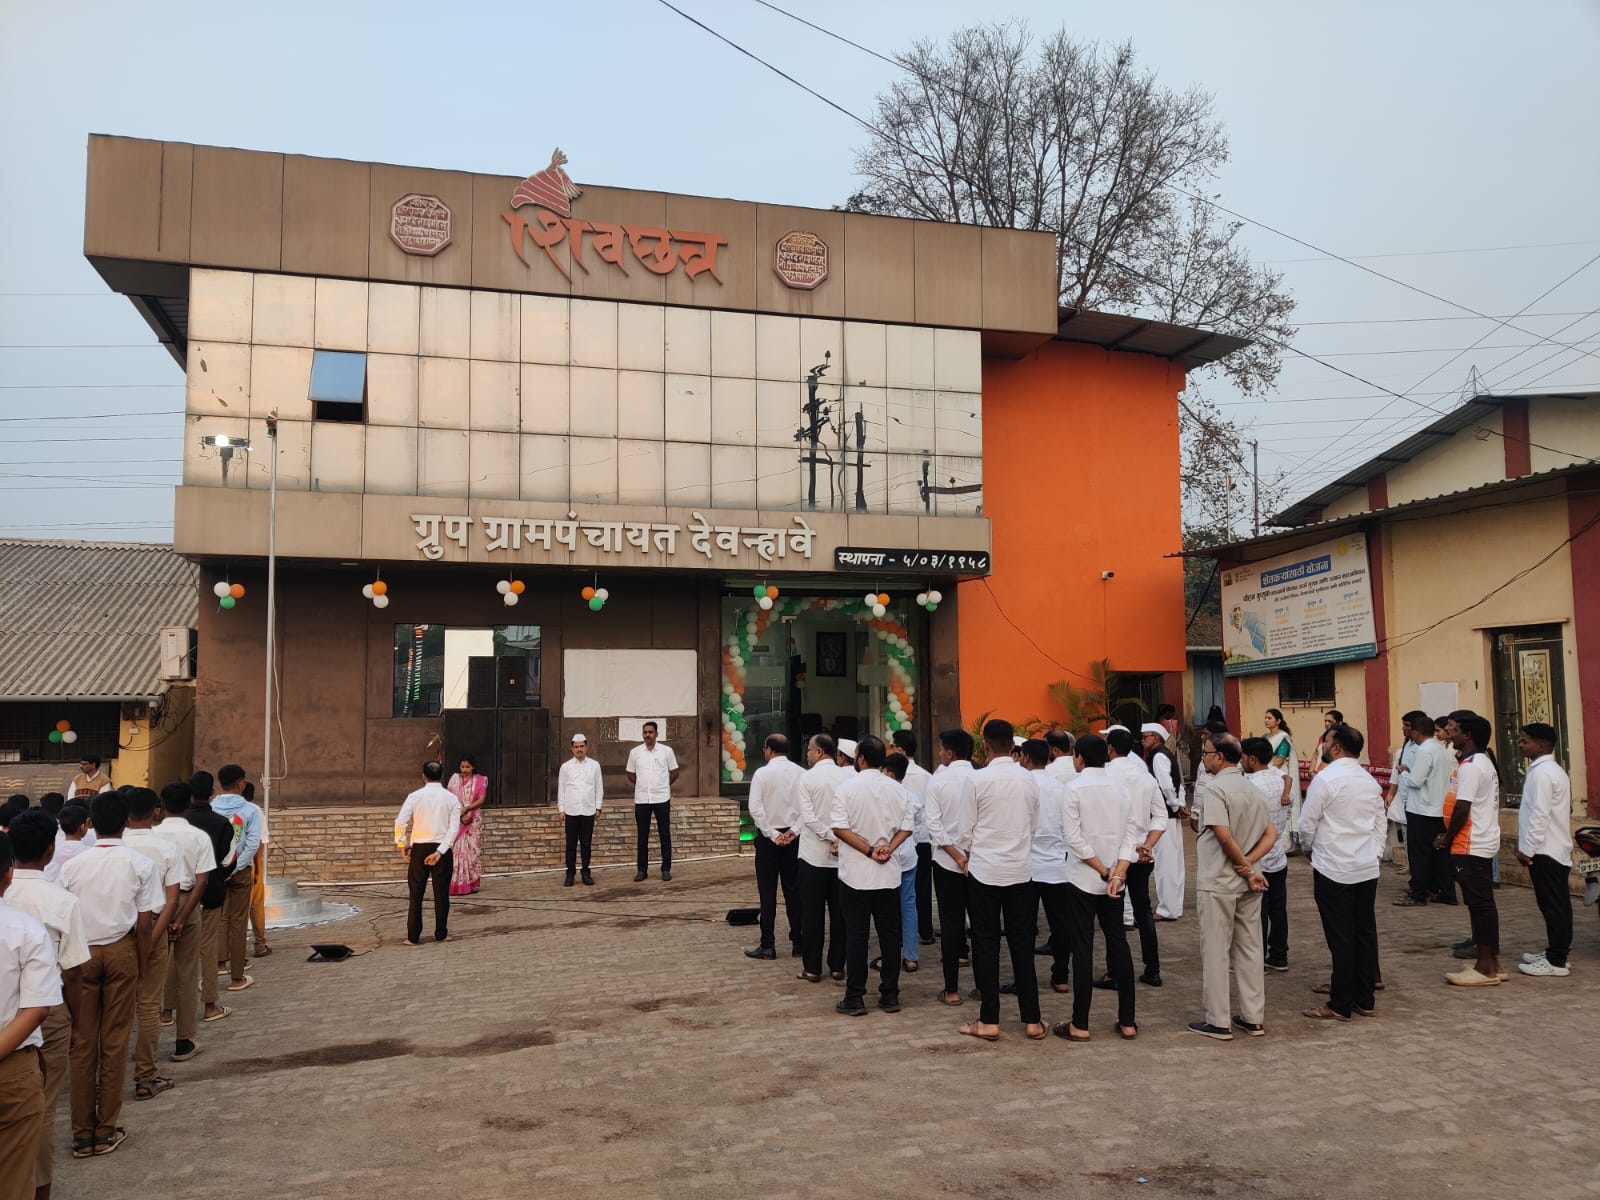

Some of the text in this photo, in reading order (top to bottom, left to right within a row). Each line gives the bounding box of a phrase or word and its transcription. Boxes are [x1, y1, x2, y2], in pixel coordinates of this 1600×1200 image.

[410, 510, 816, 561] ग्रुप ग्रामपंचायत देवन्हावे
[838, 552, 886, 566] स्थापना
[1306, 560, 1329, 575] योजना
